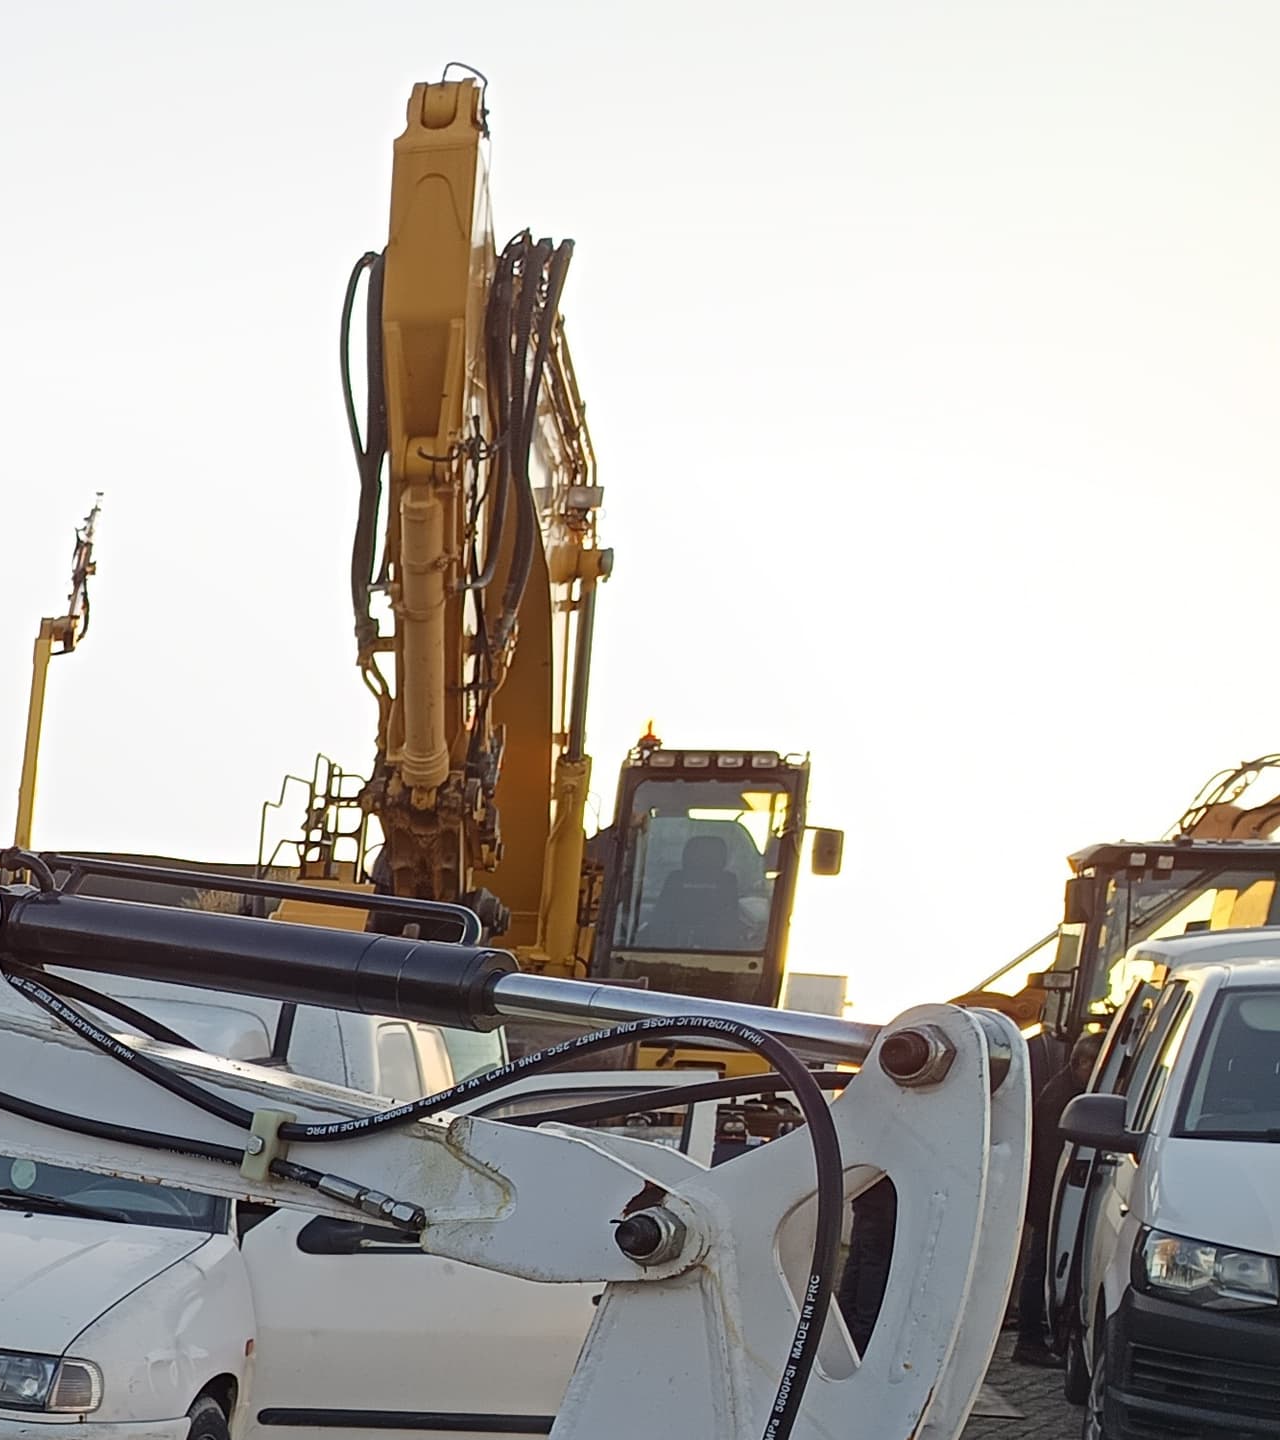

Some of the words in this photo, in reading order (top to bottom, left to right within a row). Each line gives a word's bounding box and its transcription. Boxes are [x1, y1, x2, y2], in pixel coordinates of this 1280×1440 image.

[616, 1022, 637, 1034] DIN
[641, 1017, 675, 1030] HOSE
[677, 1017, 738, 1033] HYDRAULIC
[576, 1029, 611, 1046] EN857
[739, 1027, 765, 1046] HHAI
[546, 1041, 571, 1056] 2SC
[519, 1052, 542, 1068] DN6
[305, 1126, 327, 1136] PRC
[328, 1124, 340, 1134] IN
[341, 1117, 369, 1132] MADE
[806, 1274, 821, 1303] PRC
[802, 1304, 814, 1319] IN
[791, 1321, 811, 1359] MADE
[774, 1365, 798, 1414] 5800PSI
